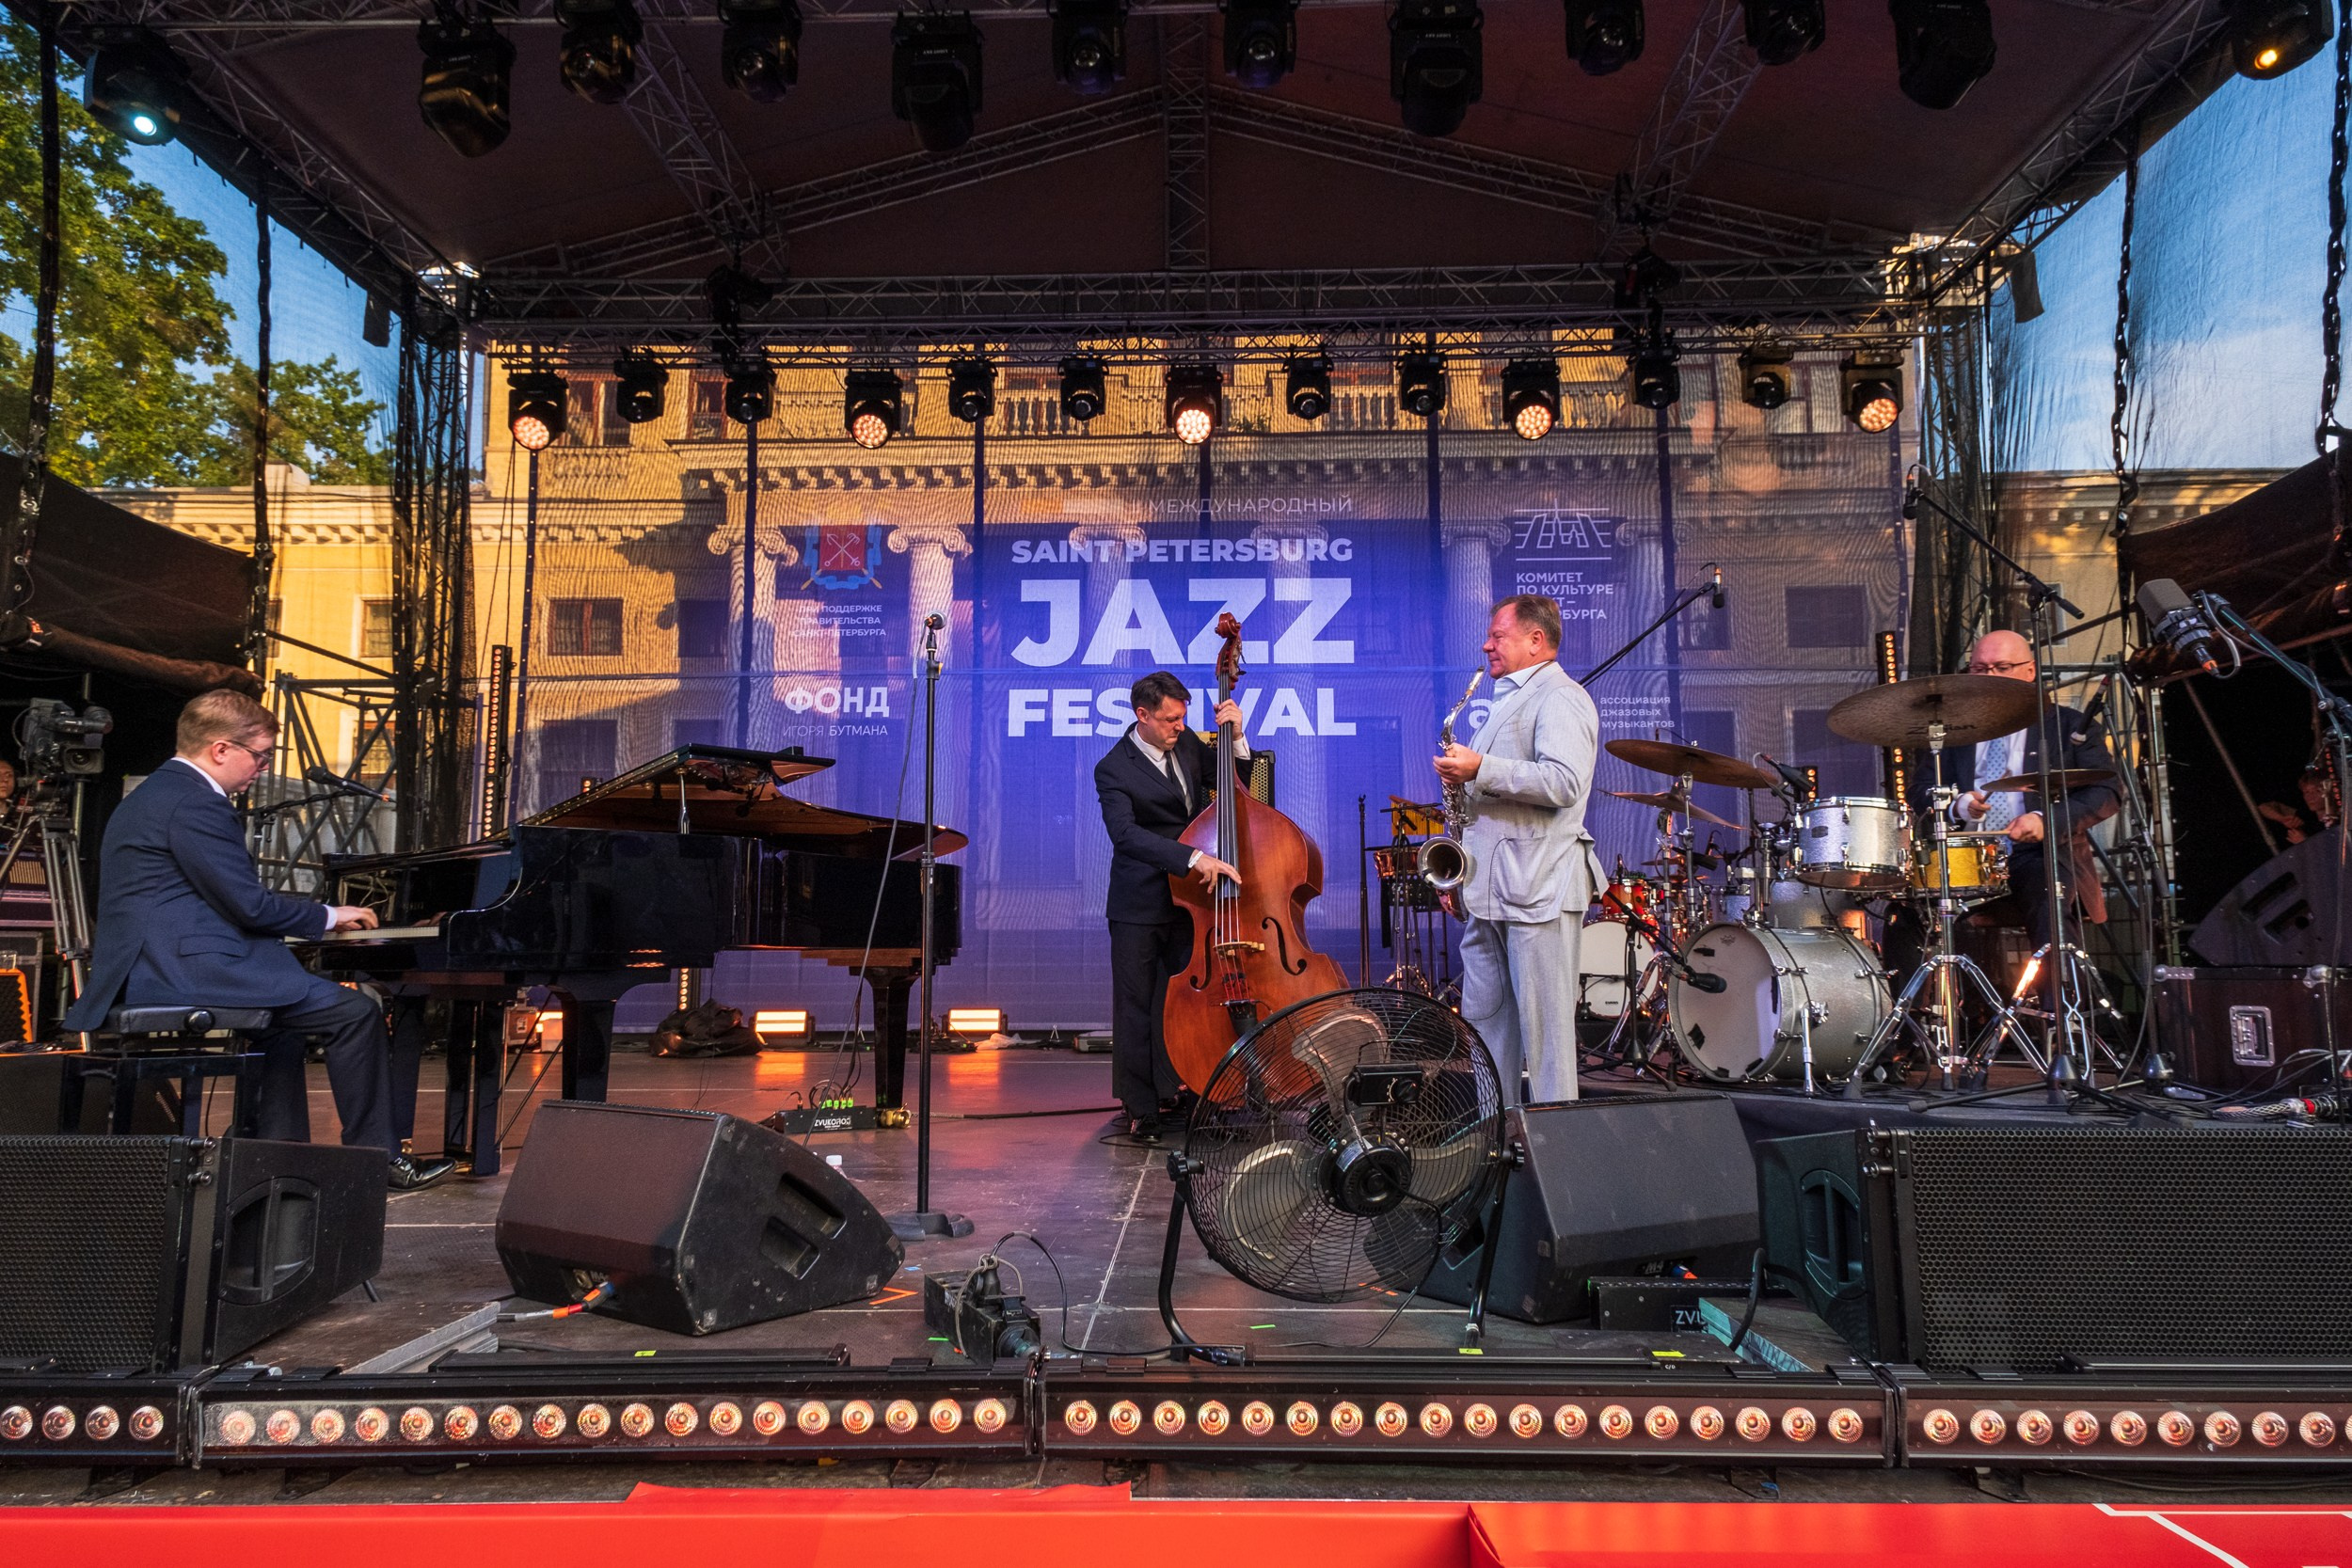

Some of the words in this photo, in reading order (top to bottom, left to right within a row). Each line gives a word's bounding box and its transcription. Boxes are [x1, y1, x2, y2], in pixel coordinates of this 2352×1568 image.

[1149, 495, 1353, 515] МЕЖДУНАРОДНЫЙ
[1011, 540, 1116, 563] SAINT
[1125, 538, 1353, 562] PETERSBURG
[1516, 572, 1583, 583] КОМИТЕТ
[1517, 585, 1538, 595] ПО
[1541, 583, 1613, 595] КУЛЬТУРЕ
[821, 605, 882, 613] ПОДДЕРЖКЕ
[800, 616, 882, 625] ПРАВИТЕЛЬСТВА
[1010, 578, 1355, 667] JAZZ
[793, 628, 887, 637] САНКТ-ПЕТЕРБУРГА
[785, 687, 890, 718] ФОНД
[1599, 696, 1671, 705] ассоциация
[1008, 687, 1357, 737] FESIVAL
[1600, 708, 1661, 717] джазовых
[783, 725, 824, 736] ИГОРЯ
[829, 724, 888, 736] БУТМАНА
[1601, 721, 1676, 730] музыкантов
